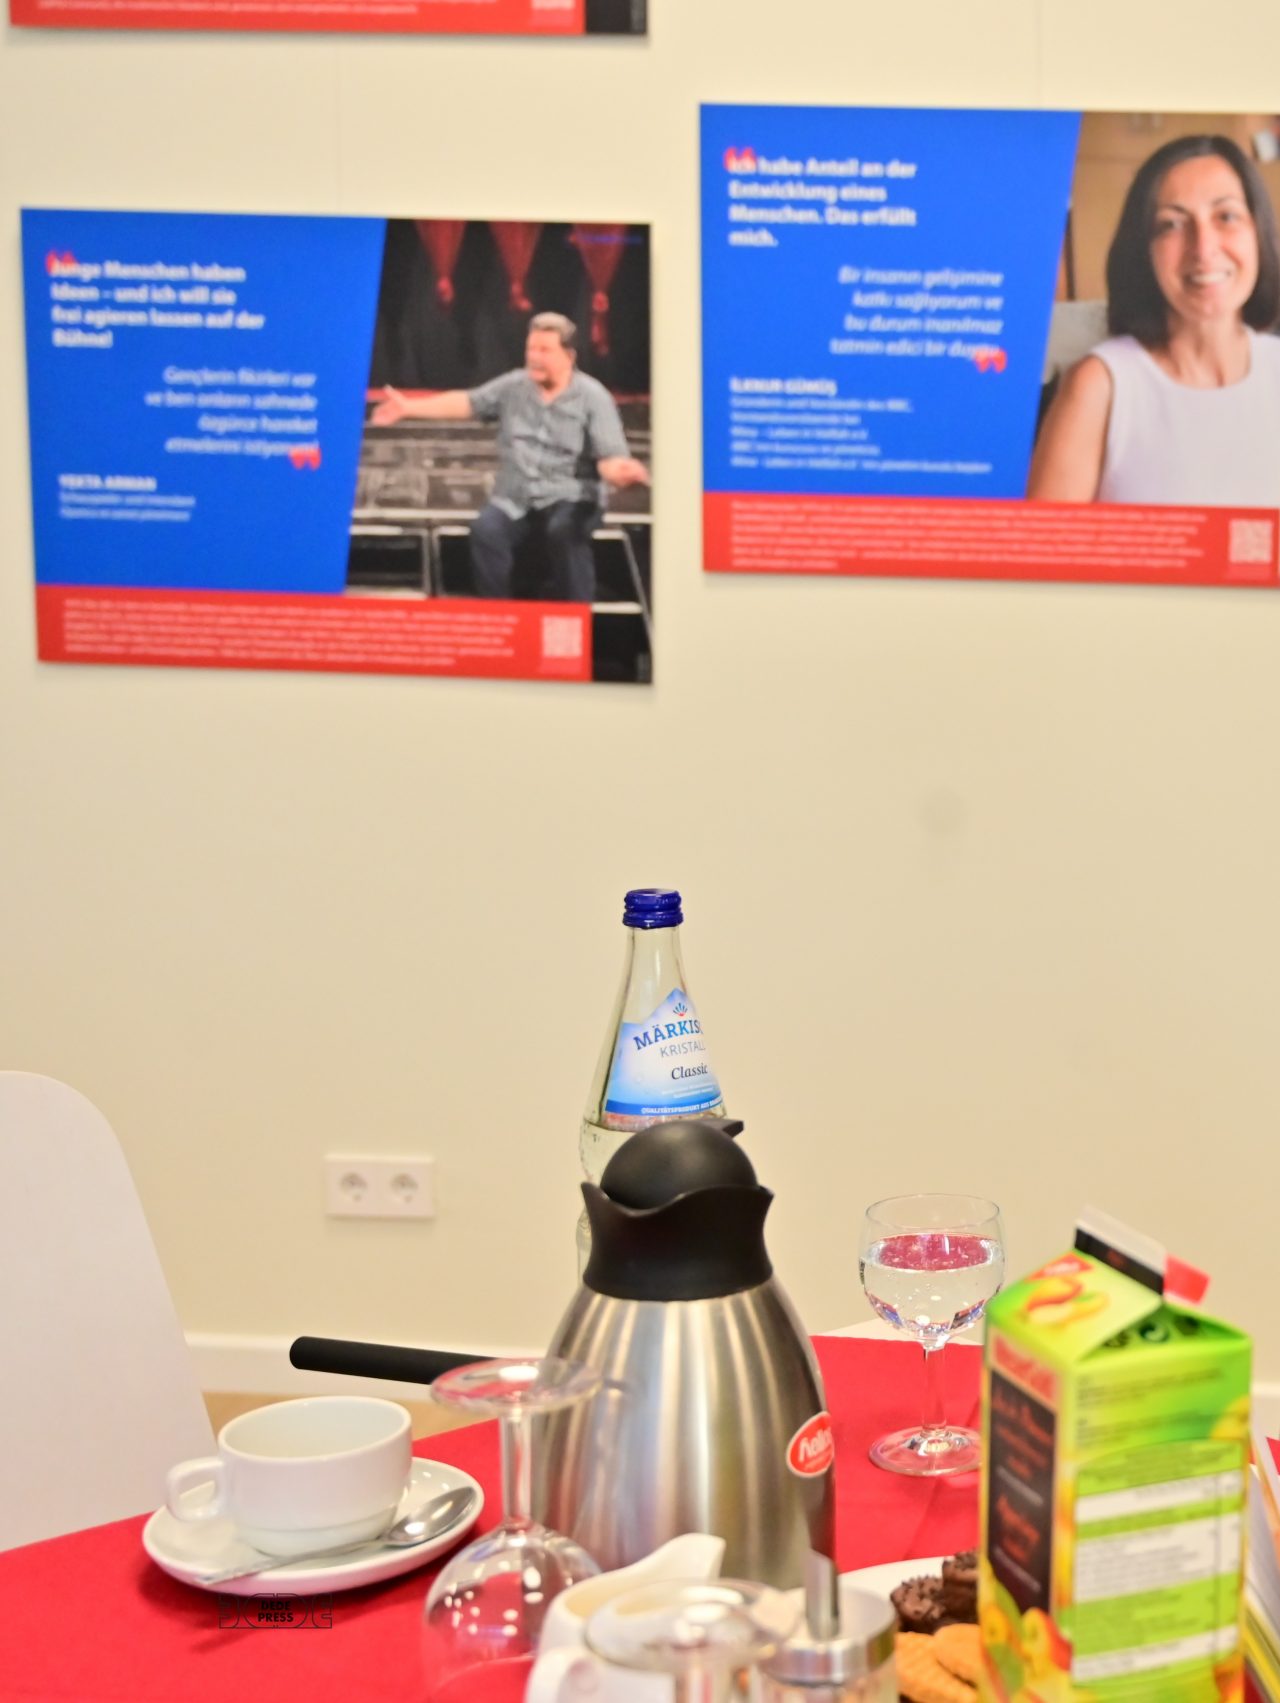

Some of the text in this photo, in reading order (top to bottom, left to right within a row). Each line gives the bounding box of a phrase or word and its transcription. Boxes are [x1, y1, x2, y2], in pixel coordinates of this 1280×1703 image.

[758, 156, 803, 176] habe
[806, 157, 859, 177] Anteil
[861, 162, 884, 178] an
[886, 159, 917, 178] der
[729, 180, 887, 204] Entwicklung eines
[729, 204, 917, 226] Menschen. Das erfüllt
[729, 228, 778, 246] mich.
[104, 260, 190, 280] Menschen
[191, 262, 246, 282] haben
[114, 285, 148, 303] und
[150, 285, 176, 303] ich
[178, 285, 210, 304] will
[212, 287, 237, 305] sie
[84, 307, 148, 329] agieren
[150, 308, 203, 327] lassen
[205, 309, 234, 328] auf
[235, 310, 265, 329] der
[633, 1019, 704, 1051] MÄRKIS
[671, 1063, 708, 1080] Classic
